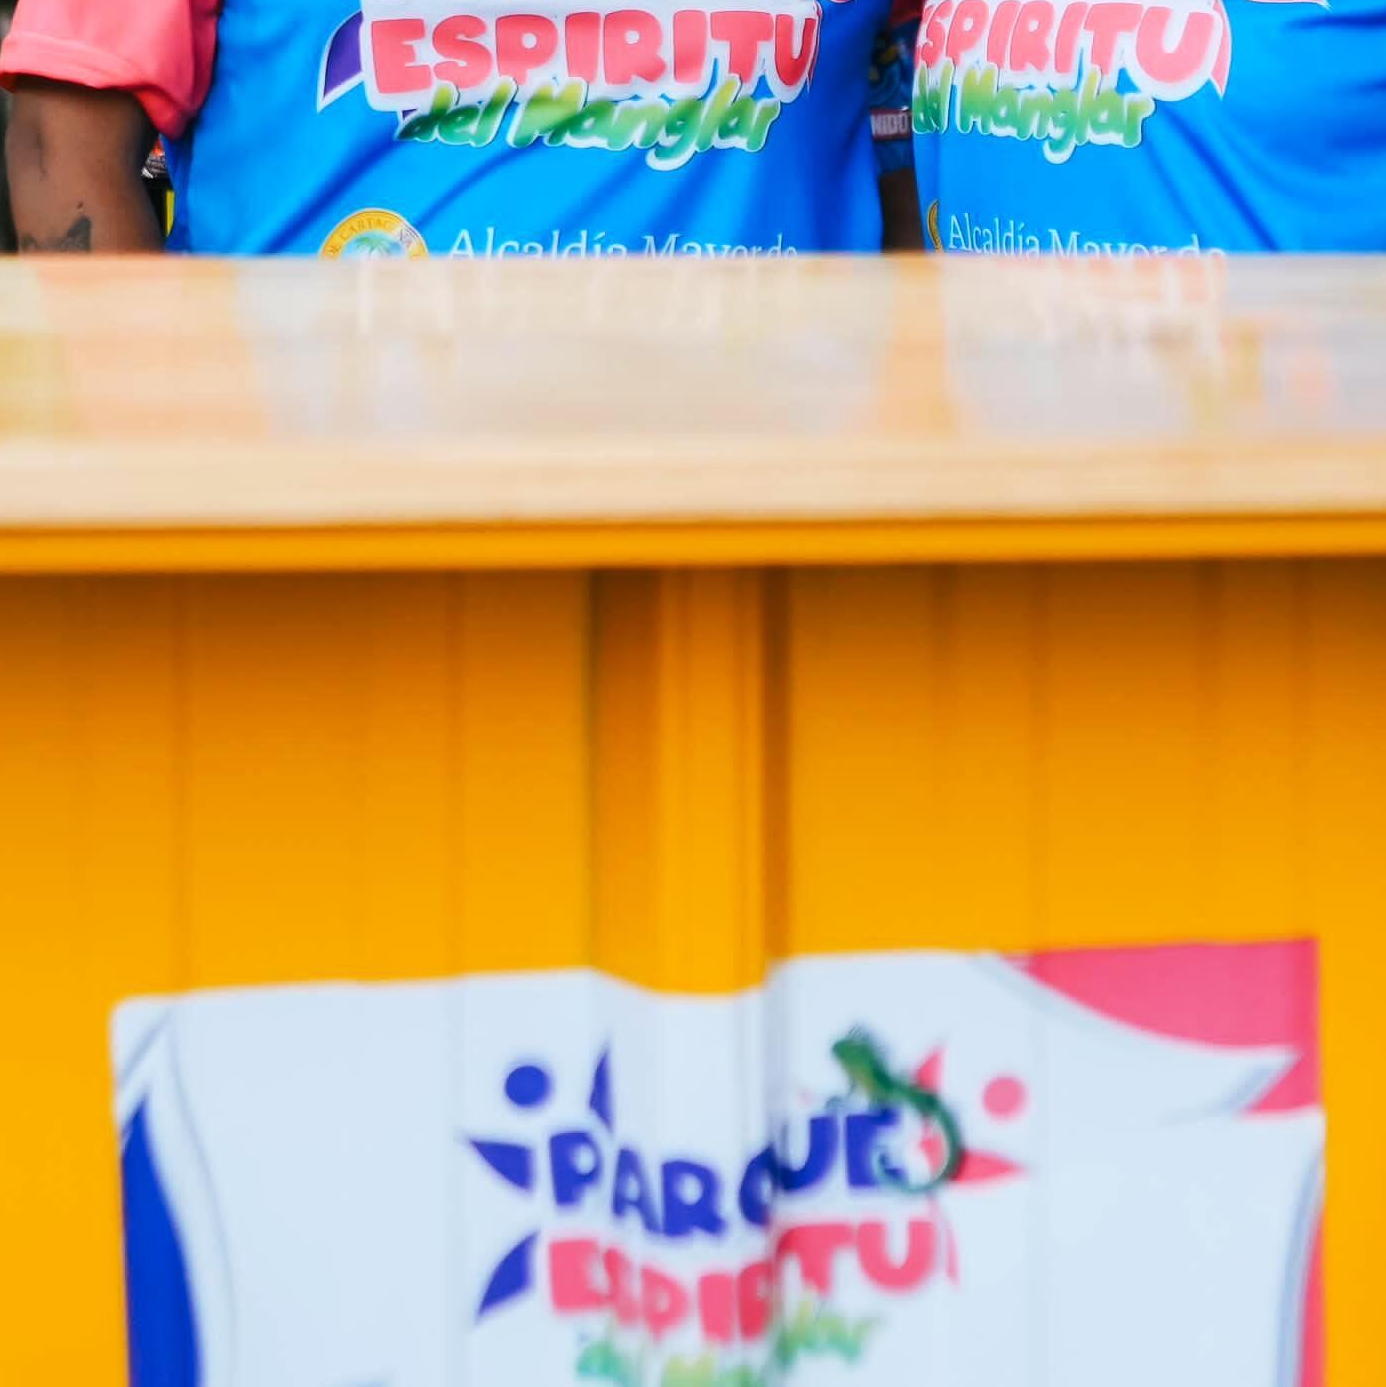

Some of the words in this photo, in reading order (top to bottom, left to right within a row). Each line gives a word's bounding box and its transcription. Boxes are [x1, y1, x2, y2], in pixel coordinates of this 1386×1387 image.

[369, 9, 815, 94] ESPIRITU
[396, 80, 517, 147] del
[509, 77, 781, 166] Manglar
[957, 61, 1152, 158] Manglar
